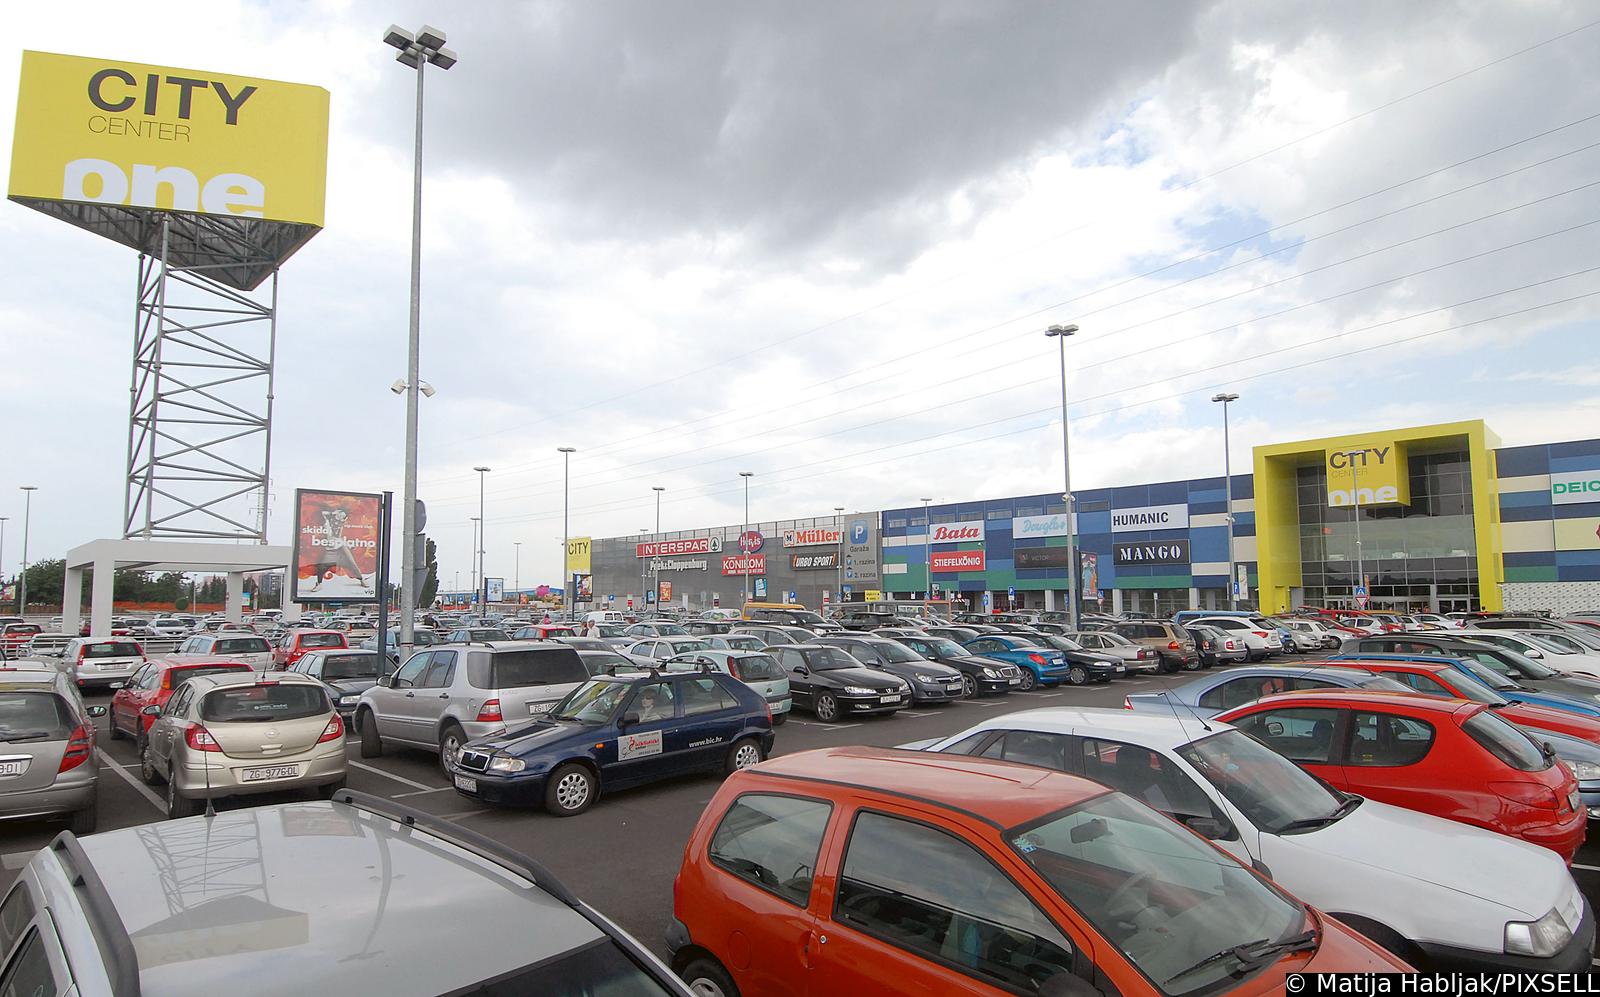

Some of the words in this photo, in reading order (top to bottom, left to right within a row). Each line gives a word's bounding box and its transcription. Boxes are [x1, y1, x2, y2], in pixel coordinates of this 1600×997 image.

[87, 68, 258, 125] CITY
[88, 115, 190, 142] CENTER
[63, 158, 265, 219] one
[1329, 447, 1390, 469] CITY
[1329, 485, 1397, 507] one
[1113, 512, 1168, 526] HUMANIC
[740, 533, 761, 548] Hrvis
[797, 529, 839, 543] Müller
[933, 526, 979, 540] Bata
[568, 542, 588, 555] CITY
[1120, 545, 1181, 560] MANGO
[934, 556, 981, 567] STIEFELKÖNIG
[250, 770, 261, 778] ZG
